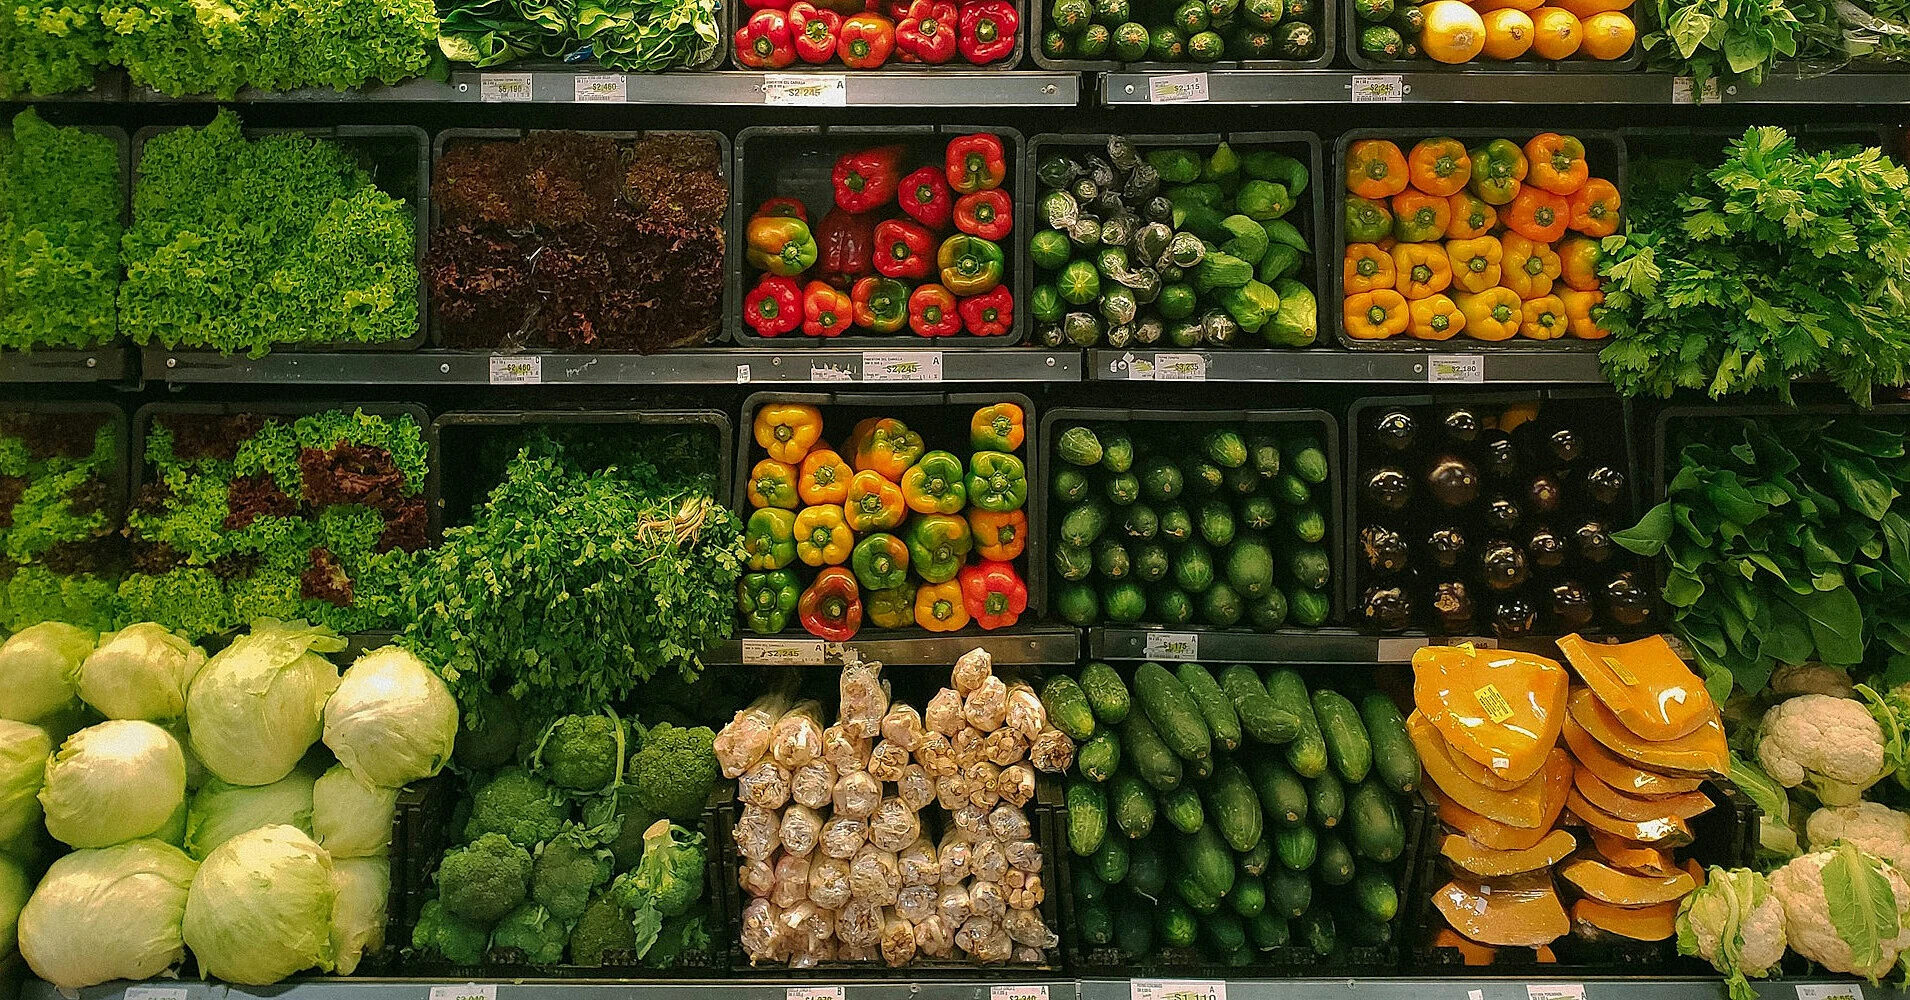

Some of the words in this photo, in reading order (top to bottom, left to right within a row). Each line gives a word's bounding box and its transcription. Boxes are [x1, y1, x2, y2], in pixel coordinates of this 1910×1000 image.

[836, 80, 844, 89] A
[932, 356, 940, 365] A
[886, 365, 917, 374] $2,245
[1191, 635, 1196, 643] A
[815, 644, 822, 652] A
[837, 986, 842, 996] B
[1040, 986, 1046, 995] A
[1209, 985, 1215, 993] A
